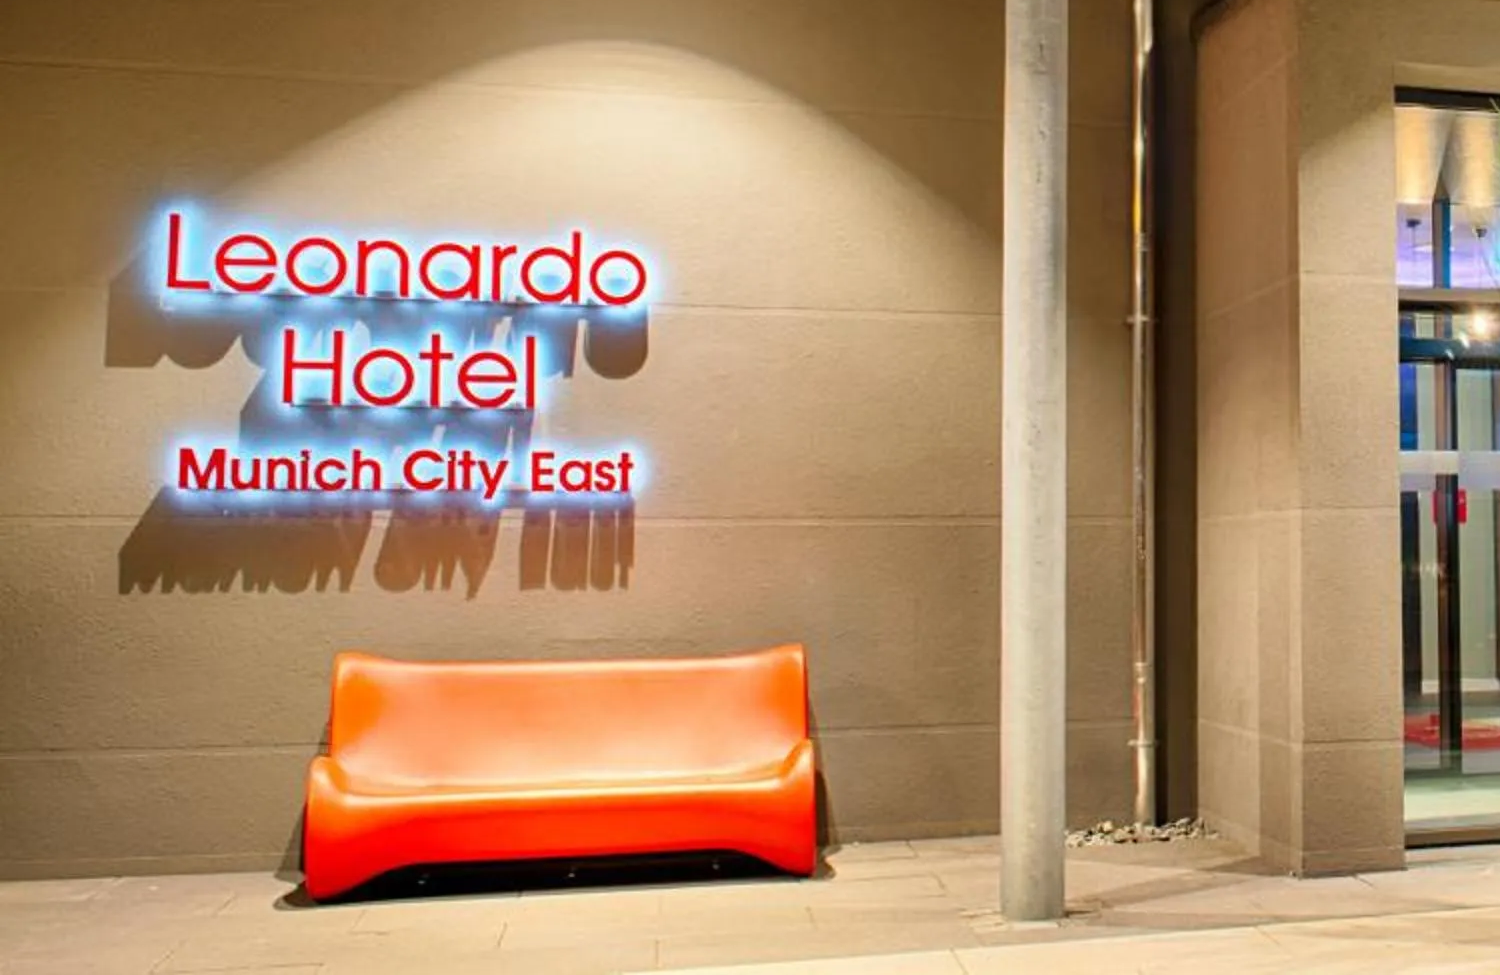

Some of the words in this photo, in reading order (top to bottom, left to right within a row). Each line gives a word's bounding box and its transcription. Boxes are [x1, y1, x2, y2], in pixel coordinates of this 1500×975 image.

[166, 213, 647, 306] Leonardo
[282, 328, 536, 410] Hotel
[178, 448, 382, 492] Munich
[403, 449, 508, 499] City
[531, 451, 634, 493] East
